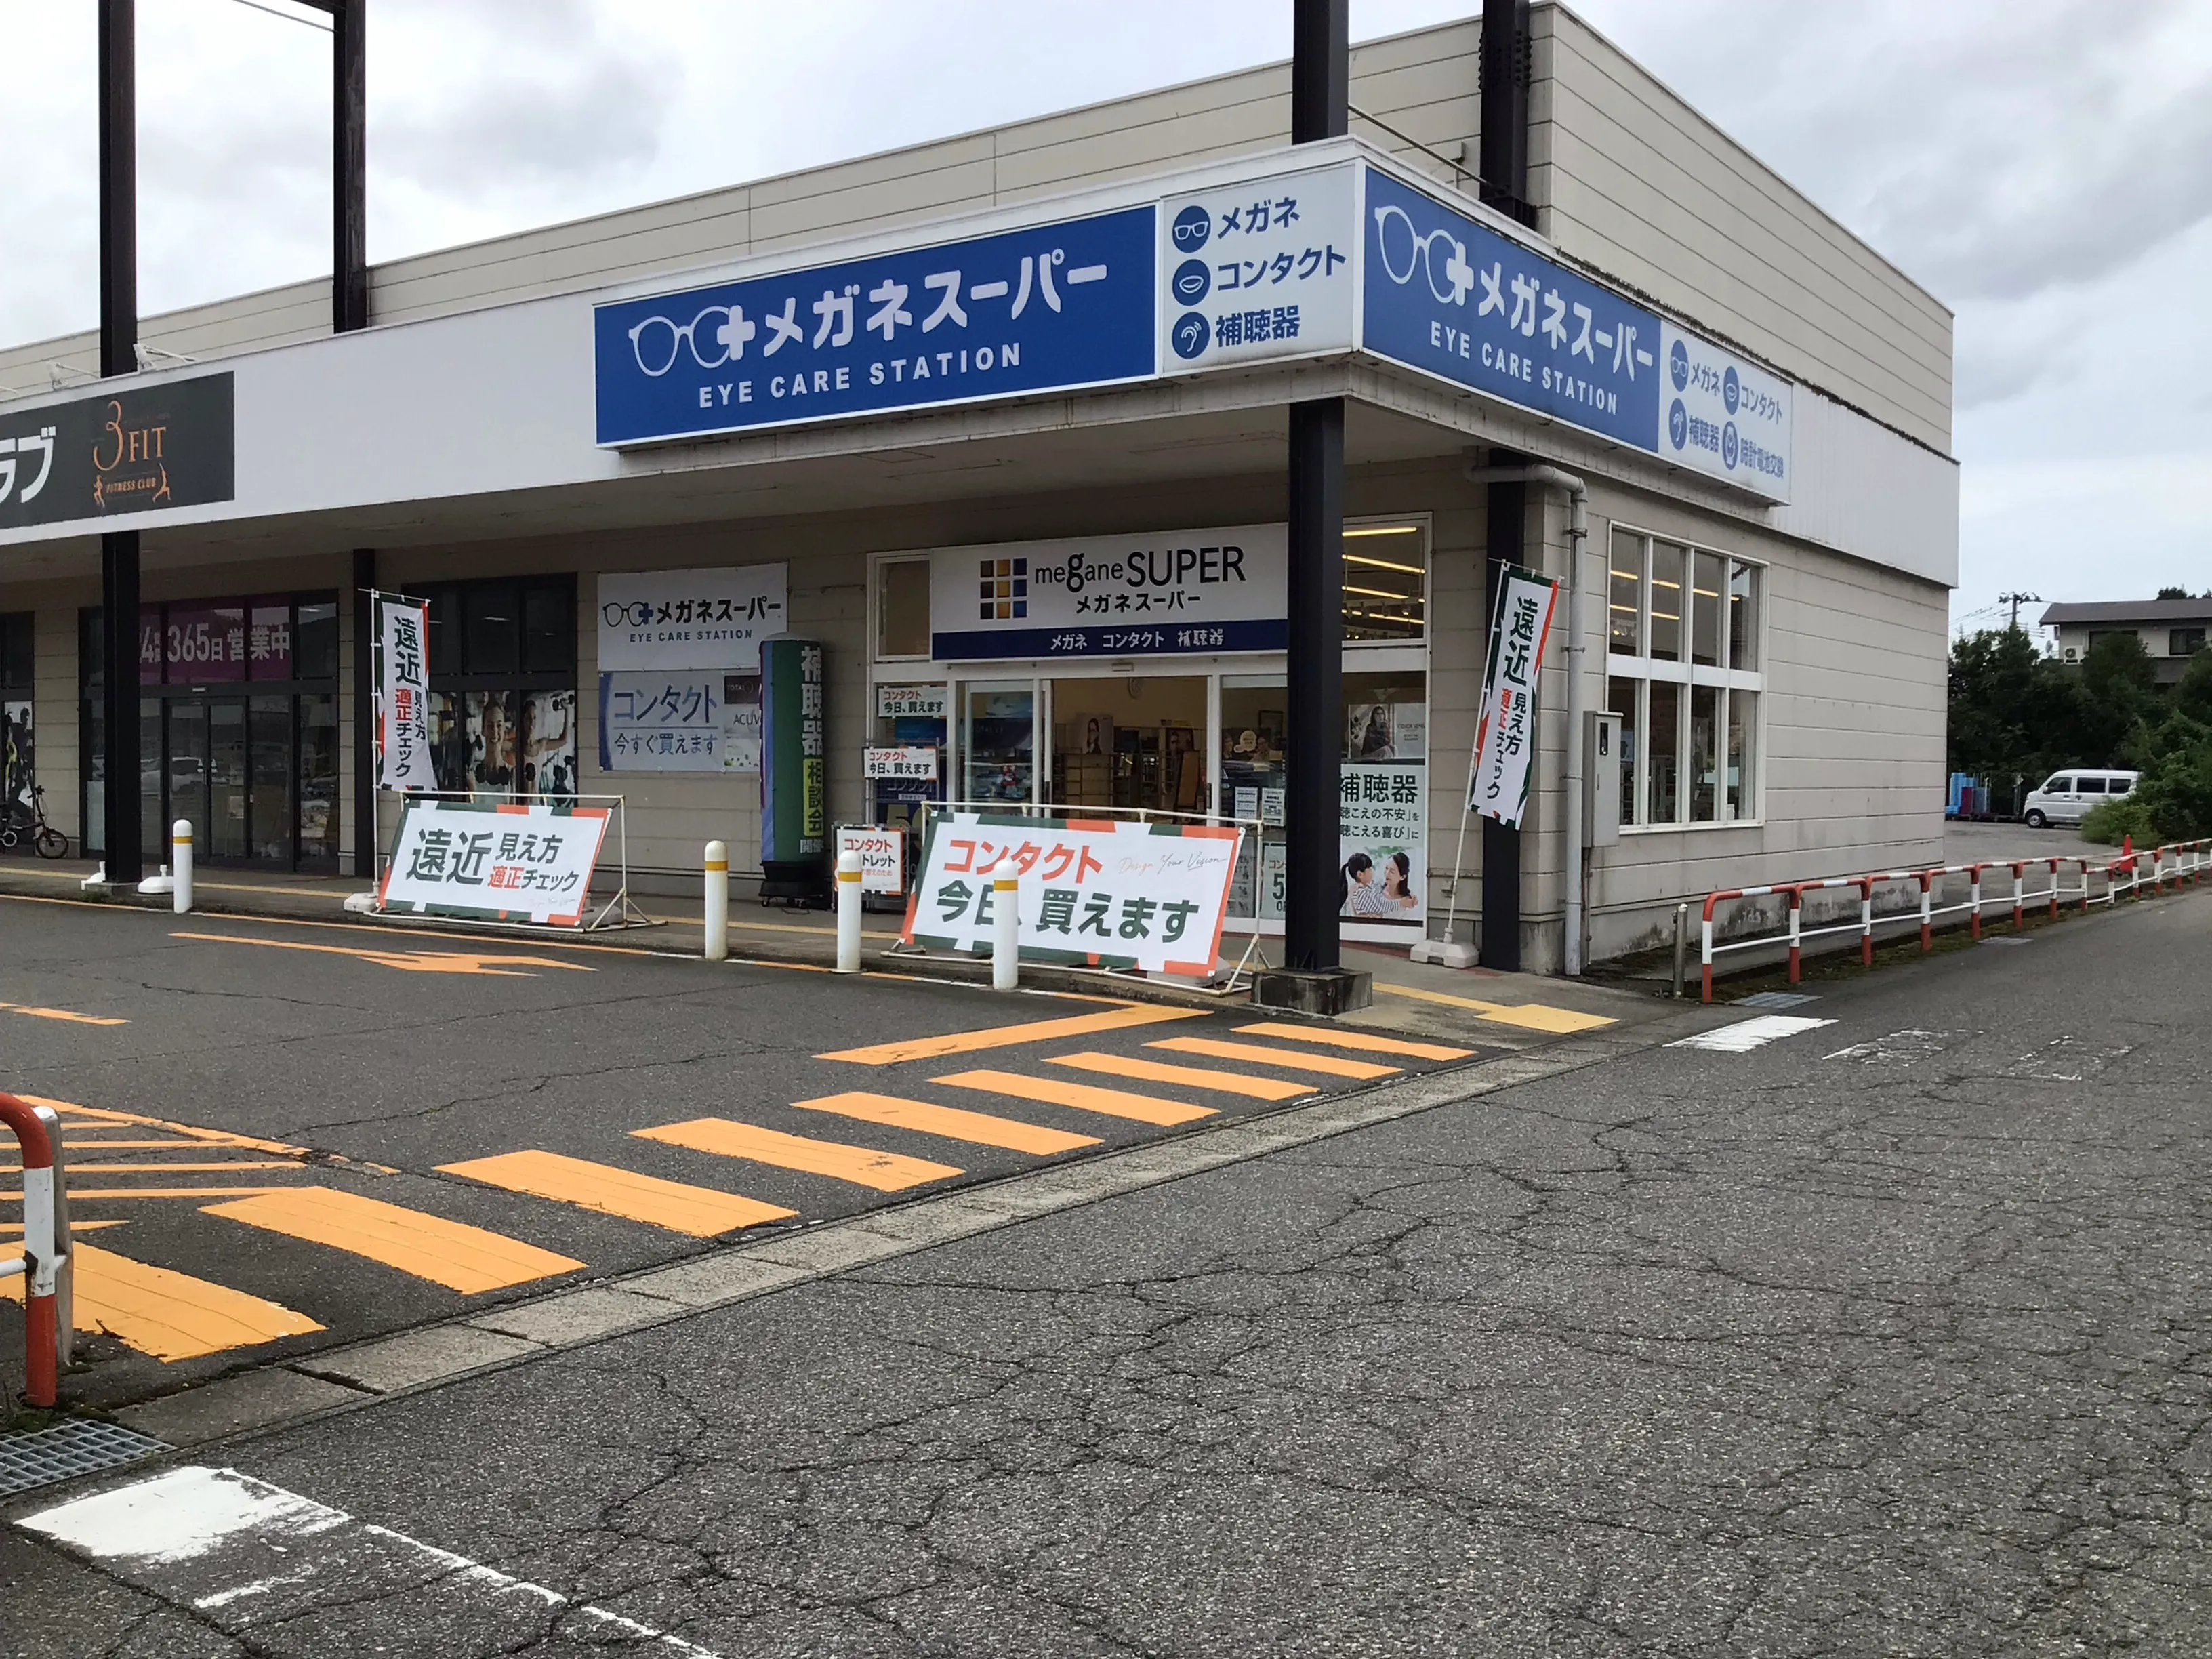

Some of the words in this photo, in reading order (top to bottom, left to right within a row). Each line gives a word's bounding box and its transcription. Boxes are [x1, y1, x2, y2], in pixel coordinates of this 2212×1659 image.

[1218, 197, 1300, 239] メガネ
[1218, 245, 1346, 291] コンタクト
[764, 248, 1108, 357] メガネスーパー
[1478, 262, 1653, 382] メガネスーパー
[1216, 305, 1300, 347] 補聴器
[700, 380, 752, 409] EYE
[771, 367, 850, 398] CARE
[869, 342, 1021, 385] STATION
[1431, 320, 1470, 359] EYE
[1481, 342, 1532, 383] CARE
[1542, 367, 1617, 415] STATION
[1691, 363, 1720, 396] メガネ
[1741, 385, 1782, 425] コンタクト
[94, 400, 124, 471] 3
[128, 427, 167, 462] FIT
[1689, 415, 1719, 453] 補聴器
[106, 480, 135, 493] FITNESS
[138, 477, 157, 489] CLUB
[657, 596, 781, 625] メガネスーパー
[1076, 590, 1201, 614] メガネスーパー
[394, 615, 422, 687] 遠近
[630, 634, 652, 642] EYE
[658, 632, 690, 641] CARE
[697, 630, 752, 640] STATION
[1050, 633, 1087, 651] メガネ
[1103, 631, 1164, 649] コンタクト
[1178, 628, 1224, 647] 補聴器
[1503, 595, 1538, 687] 遠近
[414, 690, 426, 741] 見え方
[615, 684, 717, 723] コンタクト
[801, 646, 822, 756] 補聴器
[884, 691, 922, 700] コンタクト
[884, 701, 943, 713] 今日、買えます
[395, 687, 413, 778] 適正チェック
[614, 733, 718, 755] 今すぐ買えます
[1486, 687, 1512, 799] 適正チェック
[1506, 691, 1527, 756] 見え方
[869, 752, 907, 762] コンタクト
[869, 762, 931, 775] 今日、買えます
[407, 827, 494, 886] 遠近
[495, 832, 563, 865] 見え方
[844, 838, 893, 853] コンタクト
[943, 839, 1103, 884] コンタクト
[1118, 857, 1153, 876] Design
[1156, 853, 1185, 876] Your
[1187, 851, 1228, 872] Vision
[487, 865, 579, 892] 適正チェック
[937, 880, 1200, 943] 今日買えます
